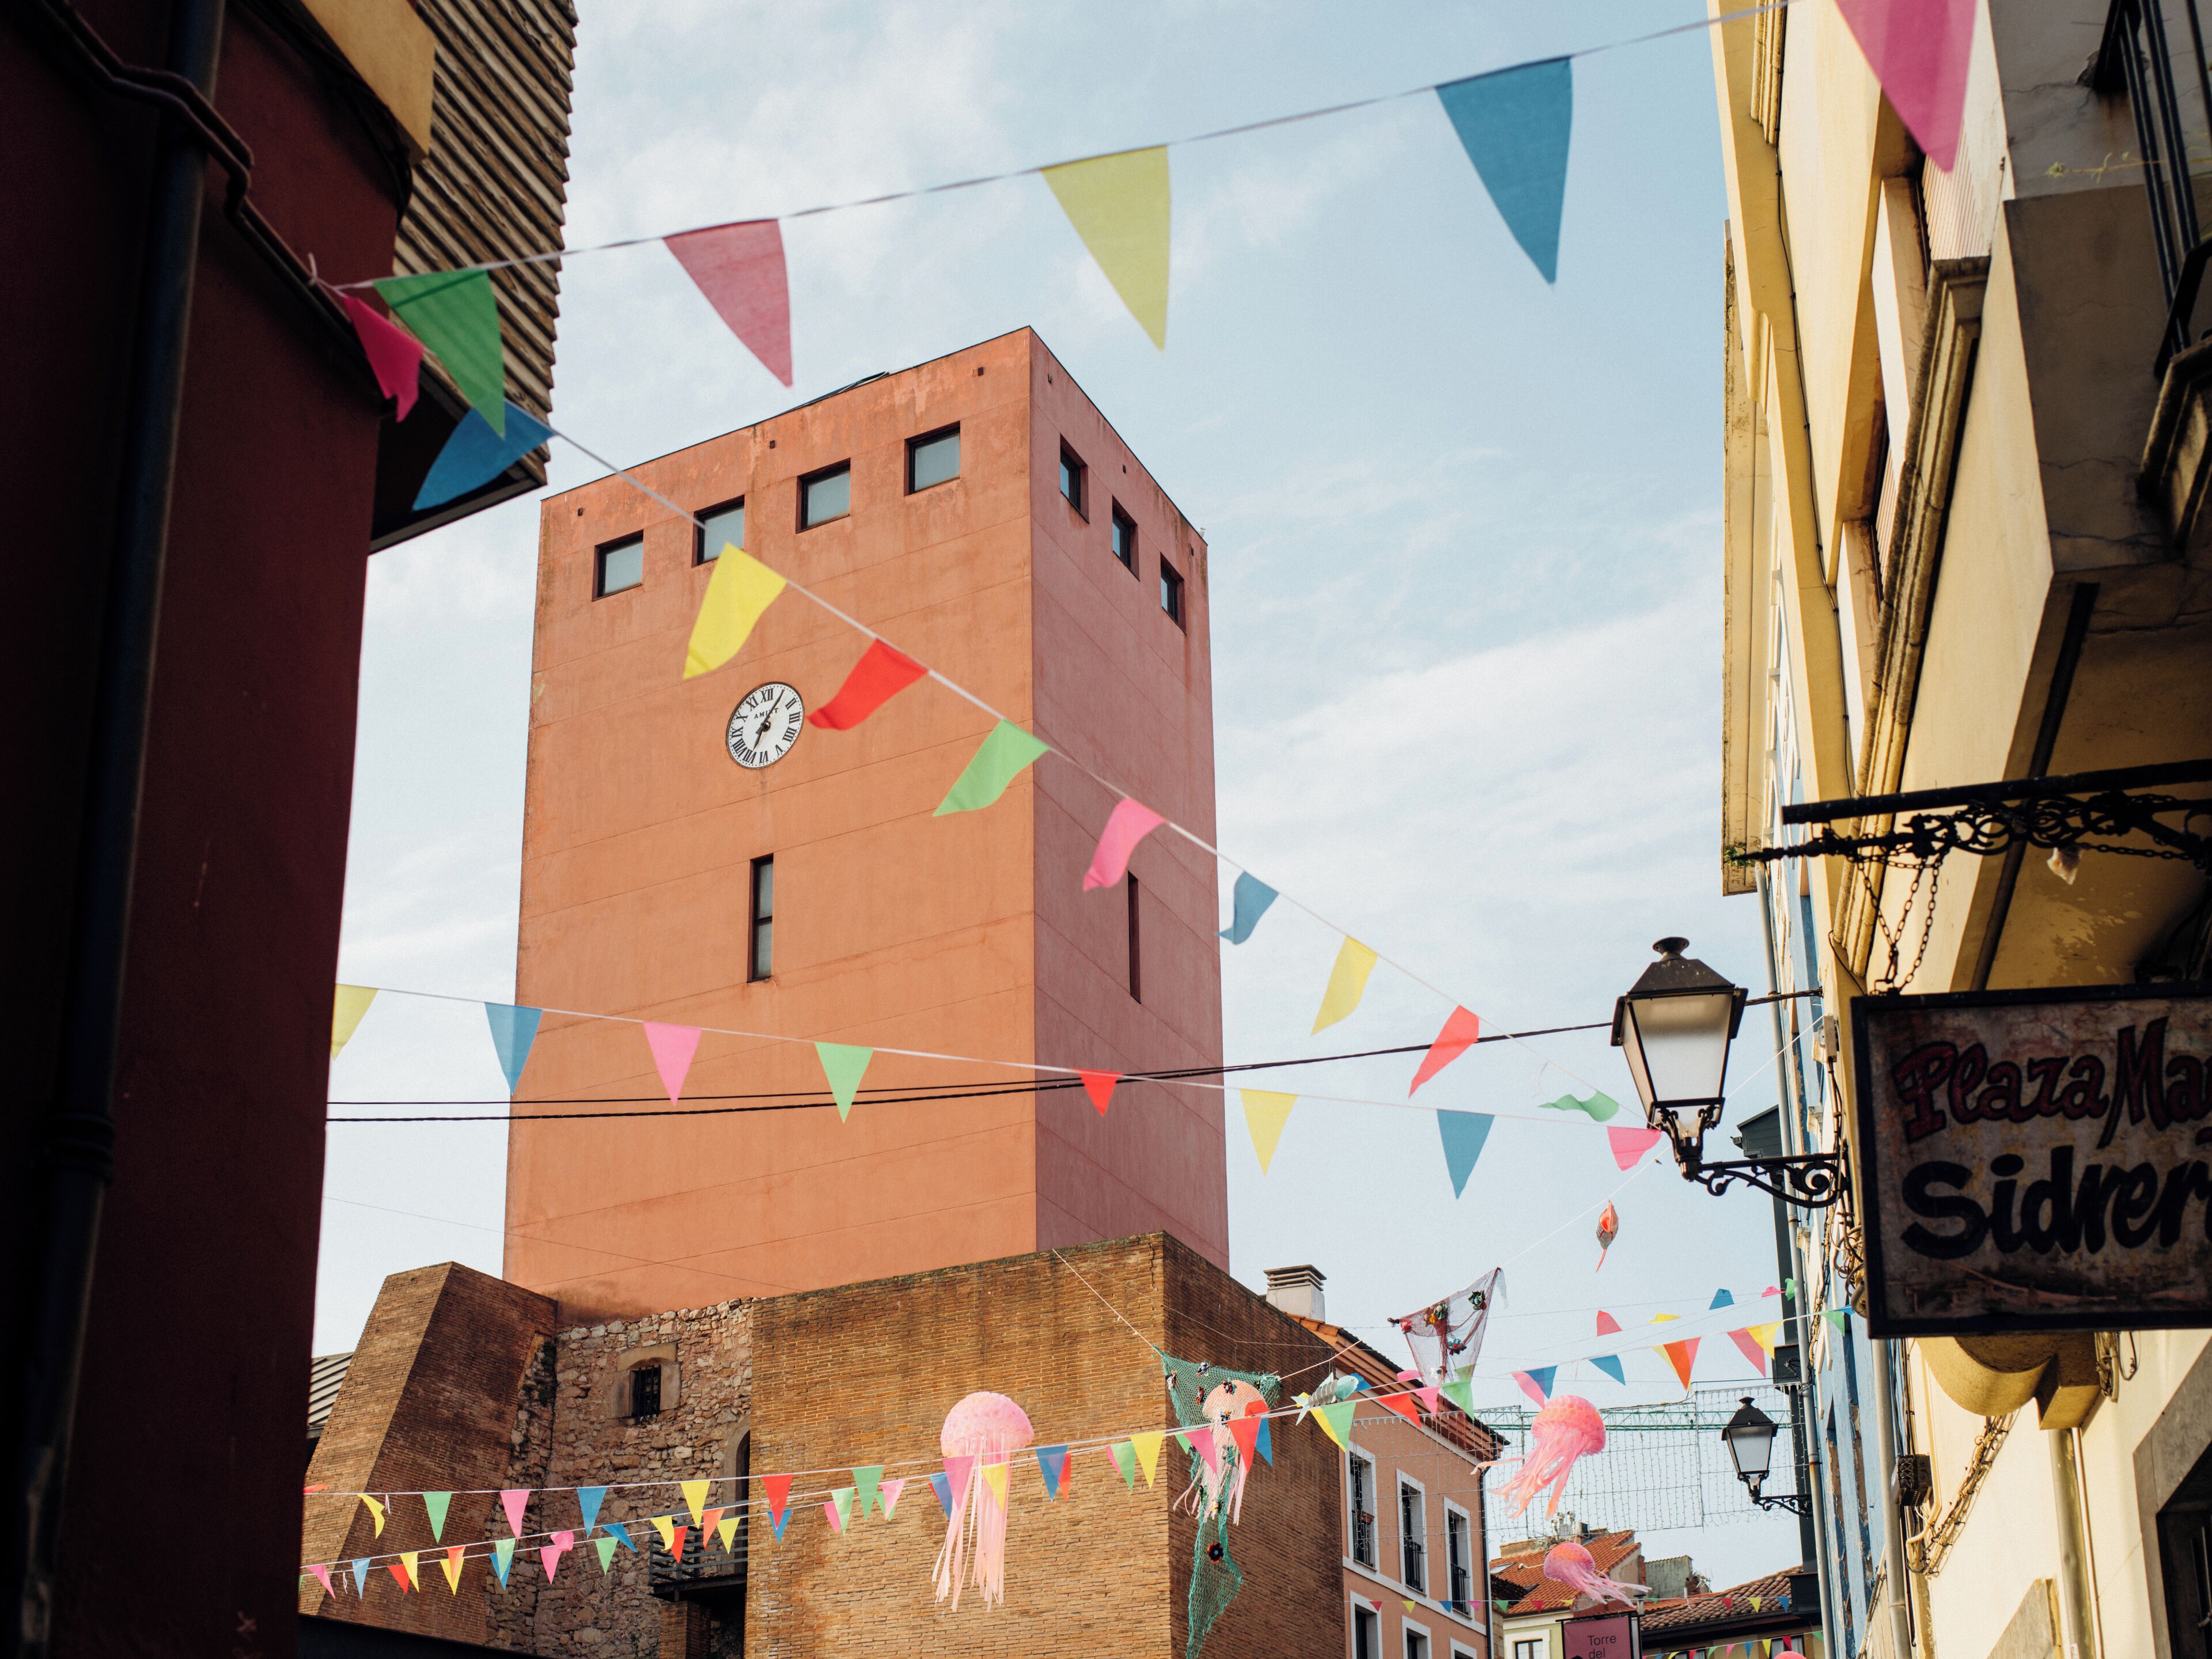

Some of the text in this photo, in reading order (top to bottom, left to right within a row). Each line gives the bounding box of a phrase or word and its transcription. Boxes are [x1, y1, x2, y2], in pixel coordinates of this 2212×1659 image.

[760, 688, 774, 703] XII
[745, 696, 759, 711] XI
[785, 697, 797, 710] II
[736, 713, 748, 722] X
[754, 707, 779, 719] AMIT
[789, 711, 801, 724] III
[732, 726, 744, 738] IX
[782, 726, 797, 743] IIII
[732, 738, 748, 757] VIII
[775, 744, 783, 756] V
[742, 749, 757, 764] VII
[759, 751, 768, 763] VI
[1892, 1016, 2212, 1149] Plaza Ma
[1588, 1635, 1616, 1646] Torre
[1589, 1647, 1605, 1659] del
